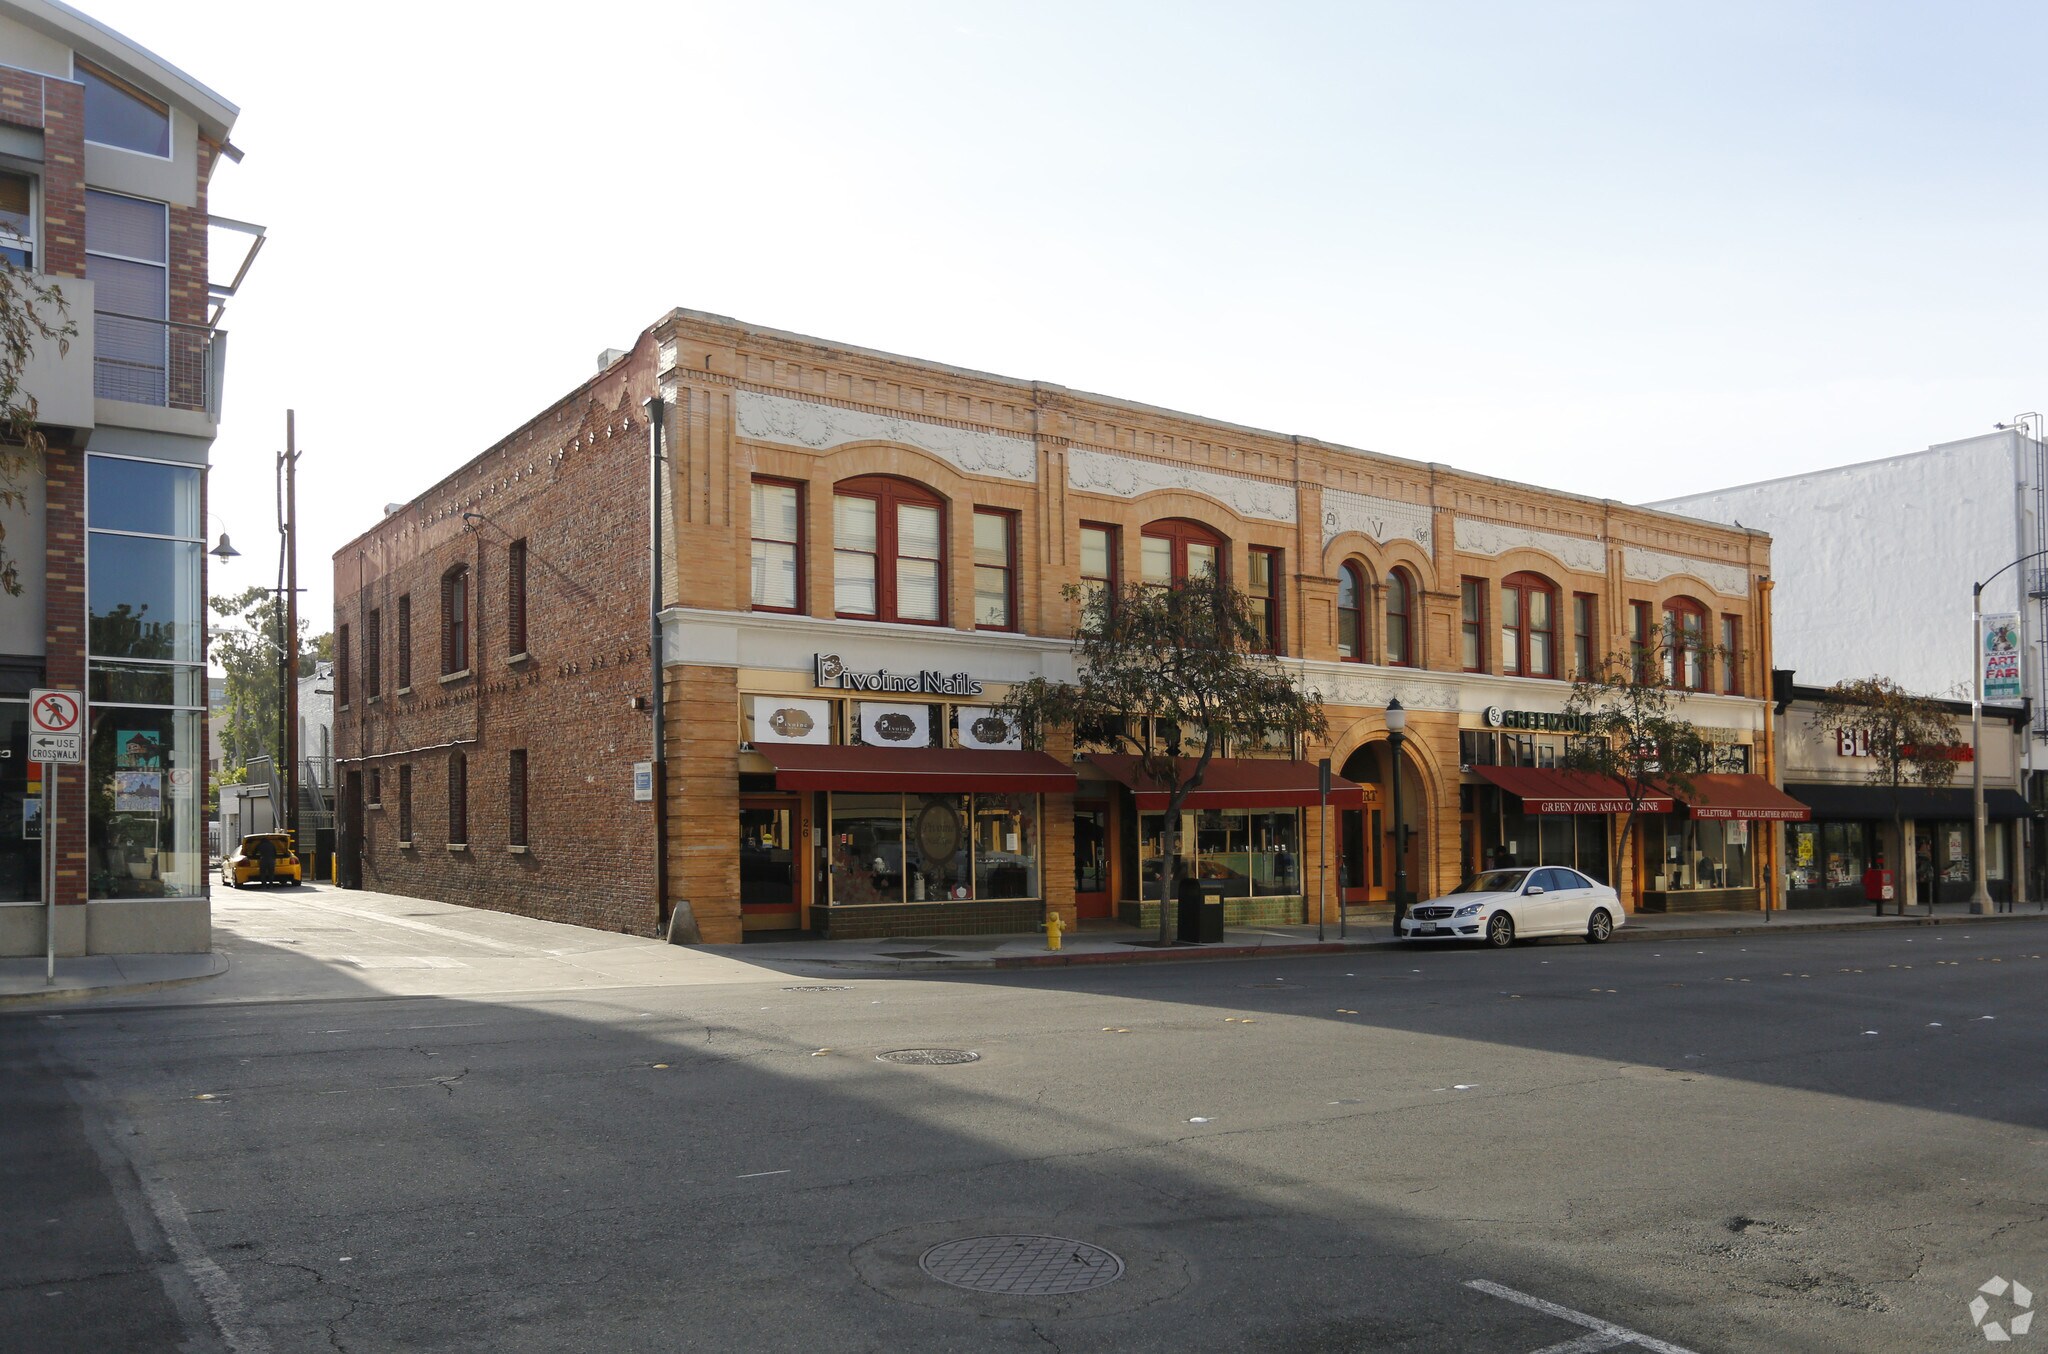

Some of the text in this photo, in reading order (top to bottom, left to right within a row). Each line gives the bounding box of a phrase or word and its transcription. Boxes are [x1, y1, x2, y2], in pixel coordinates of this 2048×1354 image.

[1988, 655, 2017, 667] ART
[814, 653, 984, 696] Pivoine Nails
[1986, 668, 2019, 679] FAIR
[56, 739, 75, 748] USE
[32, 749, 78, 759] CROSSWALK
[1541, 802, 1659, 812] GREEN ZONE ASIAN CSINE
[1697, 809, 1804, 819] PELLETTERIA ITALIAN LEATHER BOUTIQUE
